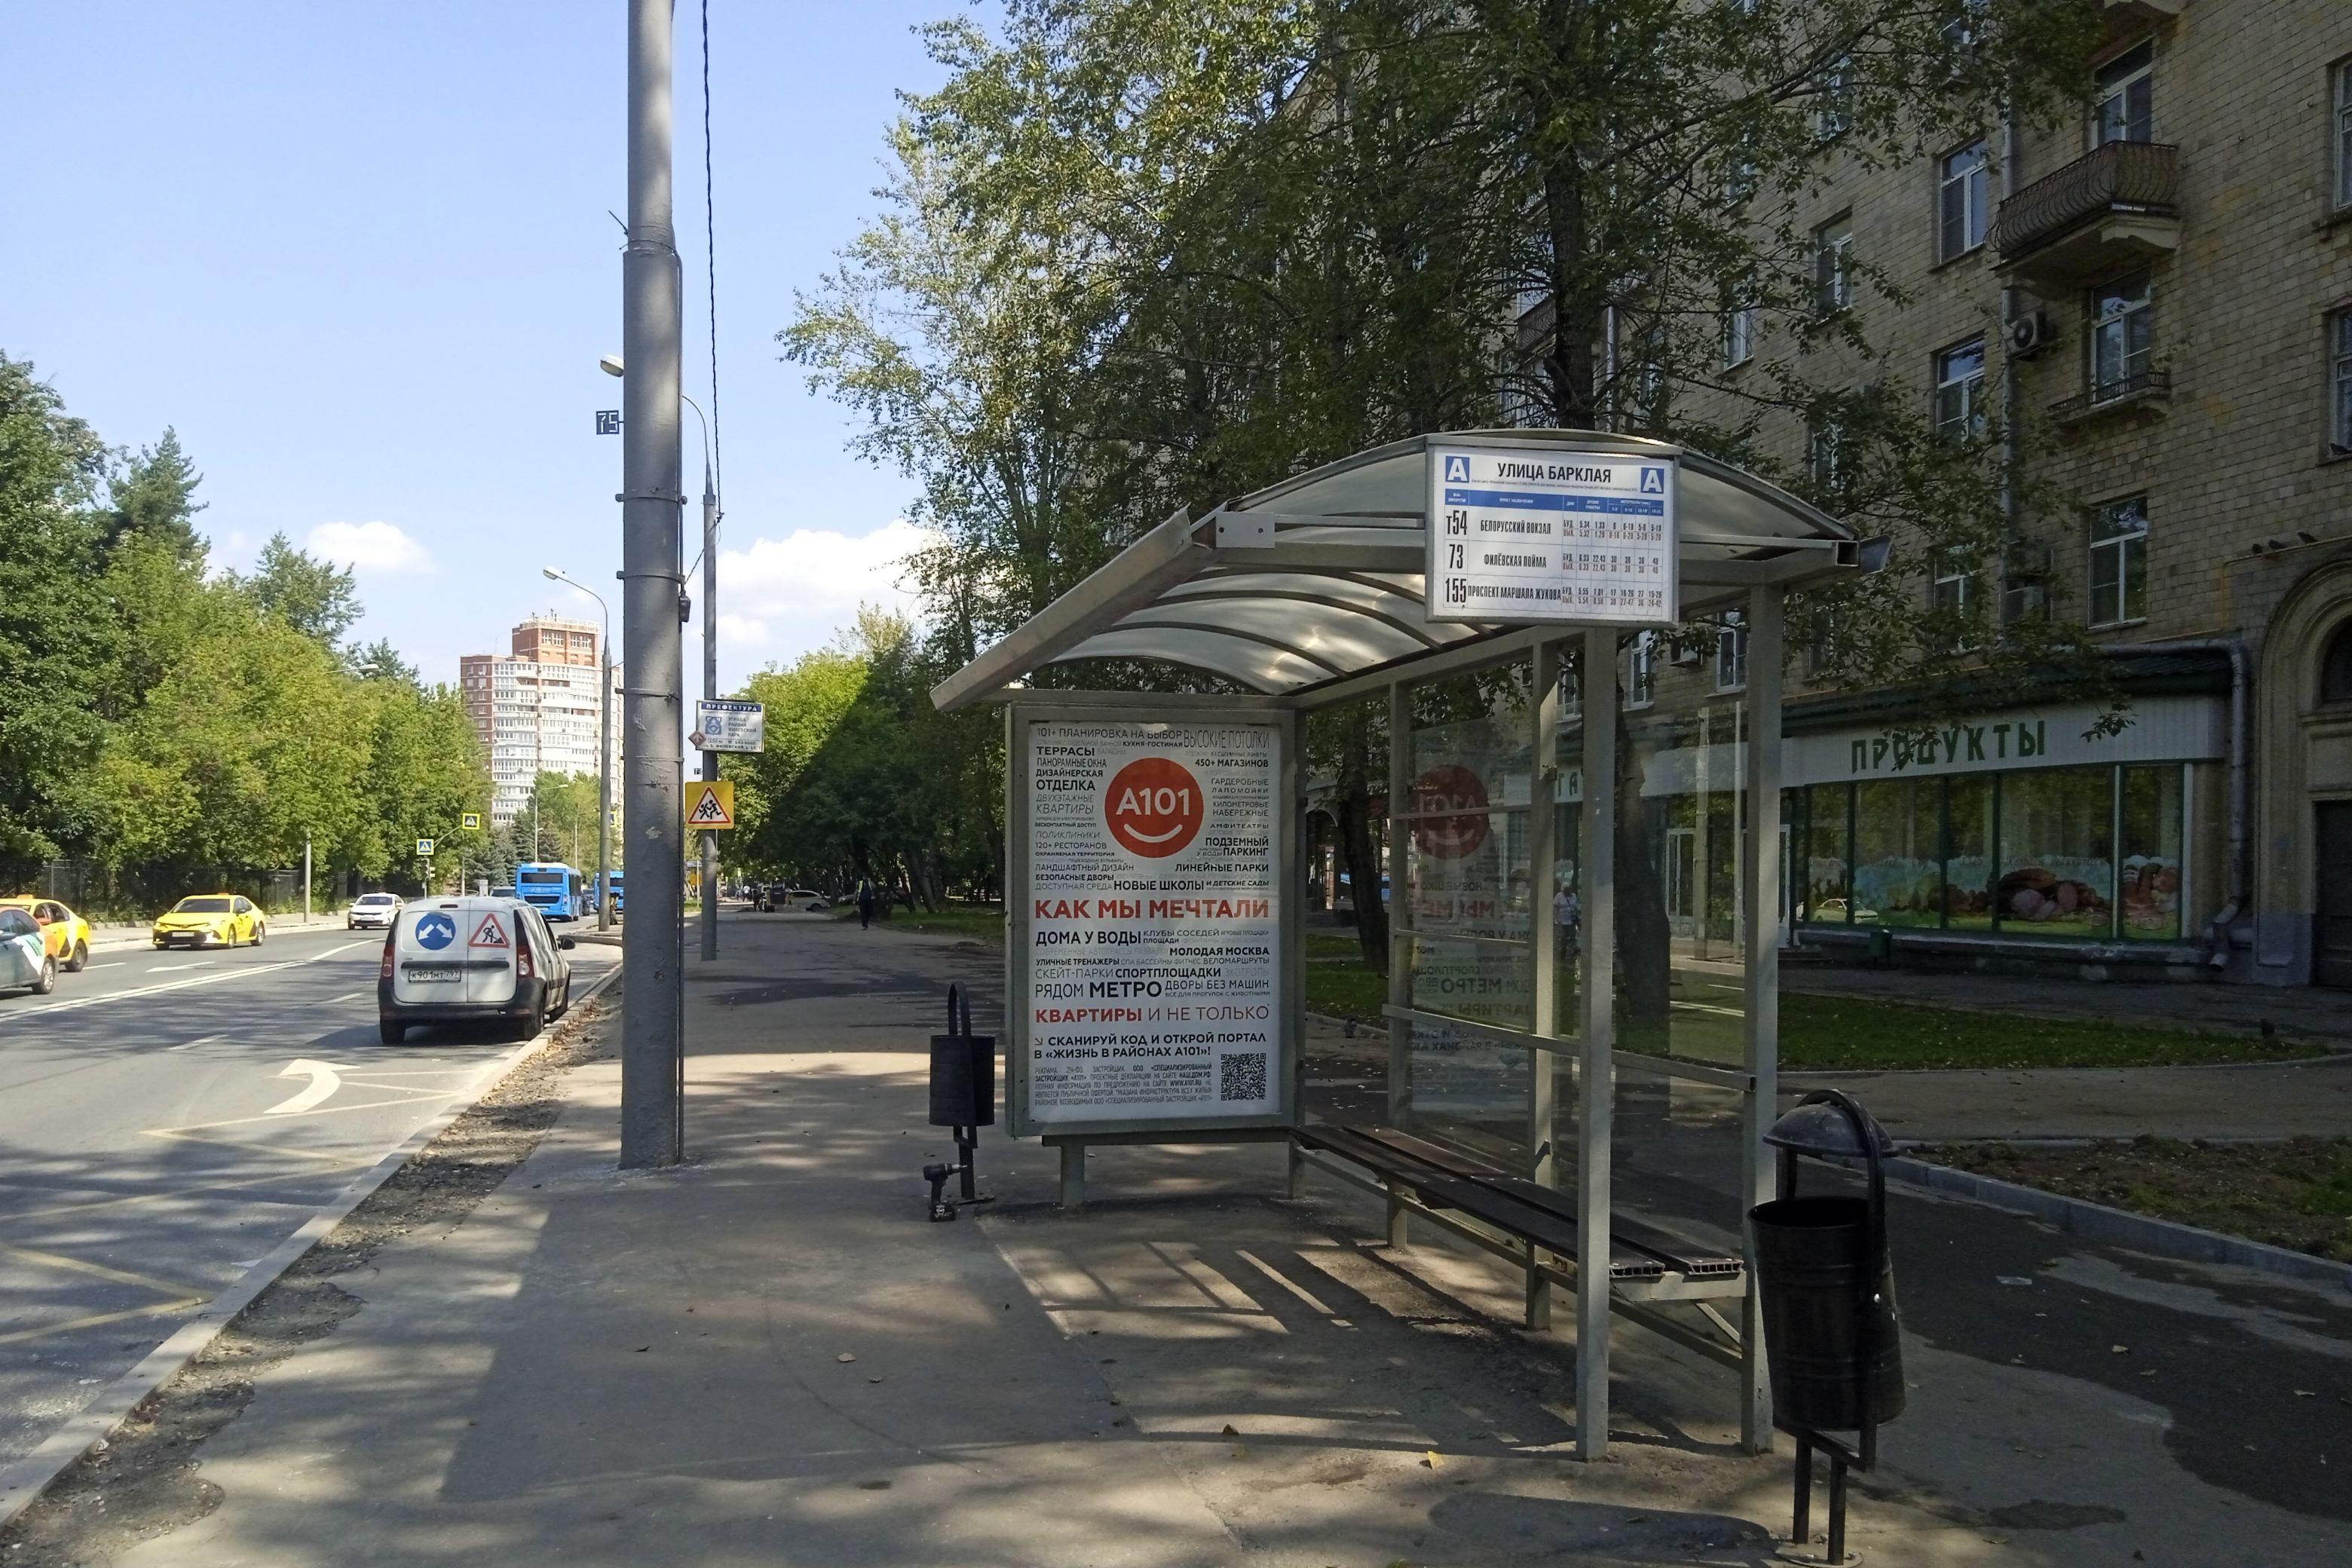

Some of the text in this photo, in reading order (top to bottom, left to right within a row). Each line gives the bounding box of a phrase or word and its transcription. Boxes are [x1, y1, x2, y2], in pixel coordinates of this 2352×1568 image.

[598, 411, 617, 433] 75
[1447, 458, 1468, 482] А
[1499, 463, 1543, 482] УЛИЦА
[1548, 467, 1611, 482] БАРКЛАЯ
[1643, 470, 1661, 492] А
[1481, 520, 1524, 533] БЕЛОРУССКИЙ
[1527, 522, 1551, 534] ВОКЗАЛ
[1449, 544, 1546, 568] 73 ФИЛЁВСКАЯ ПОЙМА
[1445, 578, 1561, 602] 155 ПРОСПЕКТ МАРШАЛА ЖУКОВА
[1060, 728, 1128, 738] ПЛАНИРОВКА
[1132, 730, 1144, 739] НА
[1147, 730, 1182, 740] ВЫБОР
[1184, 730, 1269, 748] ВЫСОКИЕ ПОТОЛКИ
[1037, 746, 1094, 755] ТЕРРАСЫ
[1851, 721, 2044, 773] ПРОДУКТЫ
[1037, 758, 1107, 767] ПАНОРАМНЫЕ ОКНА
[1037, 769, 1103, 777] ДИЗАЙНЕРСКАЯ
[1037, 779, 1095, 792] ОТДЕЛКА
[1036, 804, 1093, 813] КВАРТИРЫ
[1206, 837, 1268, 847] ПОДЗЕМНЫЙ
[1035, 863, 1134, 871] ЛАНДШАФТНЫЙ ДИЗАЙН
[1175, 862, 1232, 871] ЛИНЕЙНЫЕ
[1114, 880, 1156, 890] НОВЫЕ
[1159, 880, 1204, 890] ШКОЛЫ
[1036, 899, 1268, 918] КАК МЫ МЕЧТАЛИ
[1037, 932, 1141, 946] ДОМА У ВОДЫ
[1170, 948, 1223, 956] МОЛОДАЯ
[1036, 968, 1220, 978] СКЕЙТ-ПАРКИ СПОРТПЛОЩАДКИ
[1036, 984, 1083, 1000] РЯДОМ
[1090, 982, 1162, 997] МЕТРО
[1165, 981, 1202, 991] ДВОРЫ
[1230, 980, 1269, 988] МАШИН
[1036, 1009, 1141, 1022] КВАРТИРЫ
[1148, 1009, 1159, 1021] И
[1168, 1008, 1190, 1021] НЕ
[1049, 1032, 1266, 1046] СКАНИРУЙ КОД И ОТКРОЙ ПОРТАЛ
[1035, 1050, 1041, 1059] В
[1046, 1049, 1098, 1058] «ЖИЗНЬ
[1101, 1049, 1109, 1057] В
[1113, 1046, 1171, 1057] РАЙОНАХ
